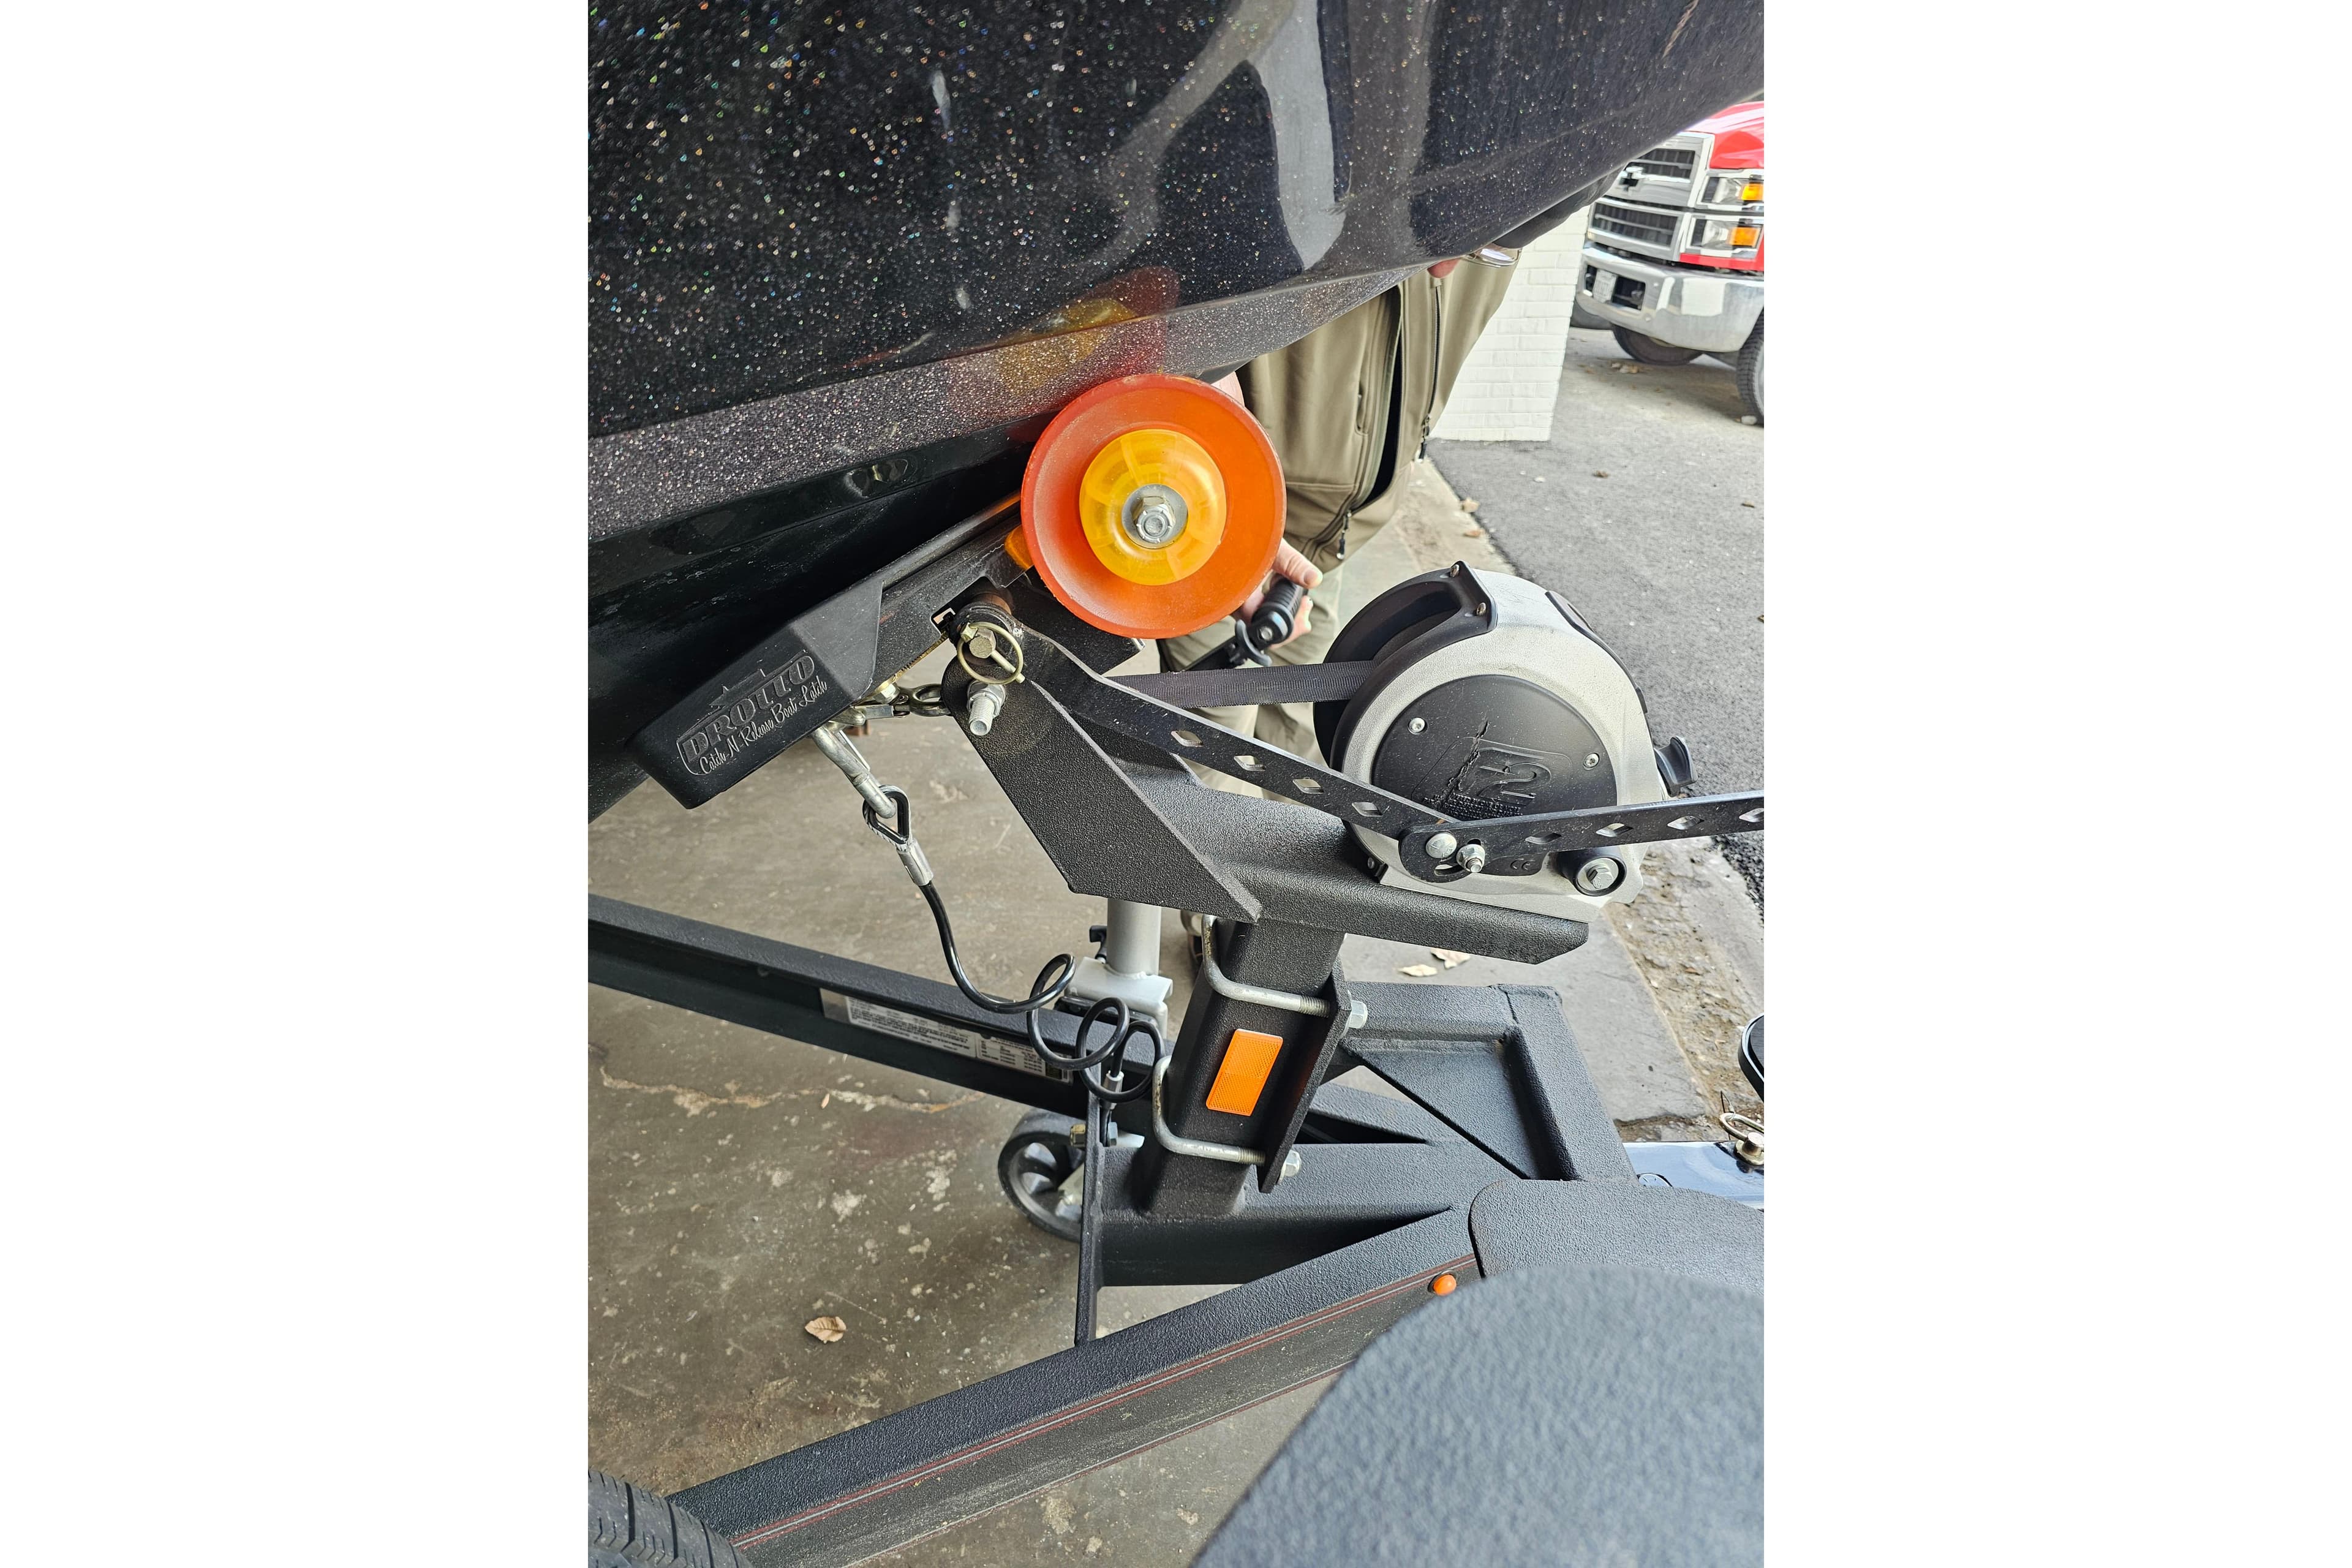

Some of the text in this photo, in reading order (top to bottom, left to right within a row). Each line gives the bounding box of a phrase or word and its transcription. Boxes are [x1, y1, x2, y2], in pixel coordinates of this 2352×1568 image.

[682, 655, 815, 763] DROTTO
[771, 696, 797, 724] Boat
[798, 675, 827, 707] Latch
